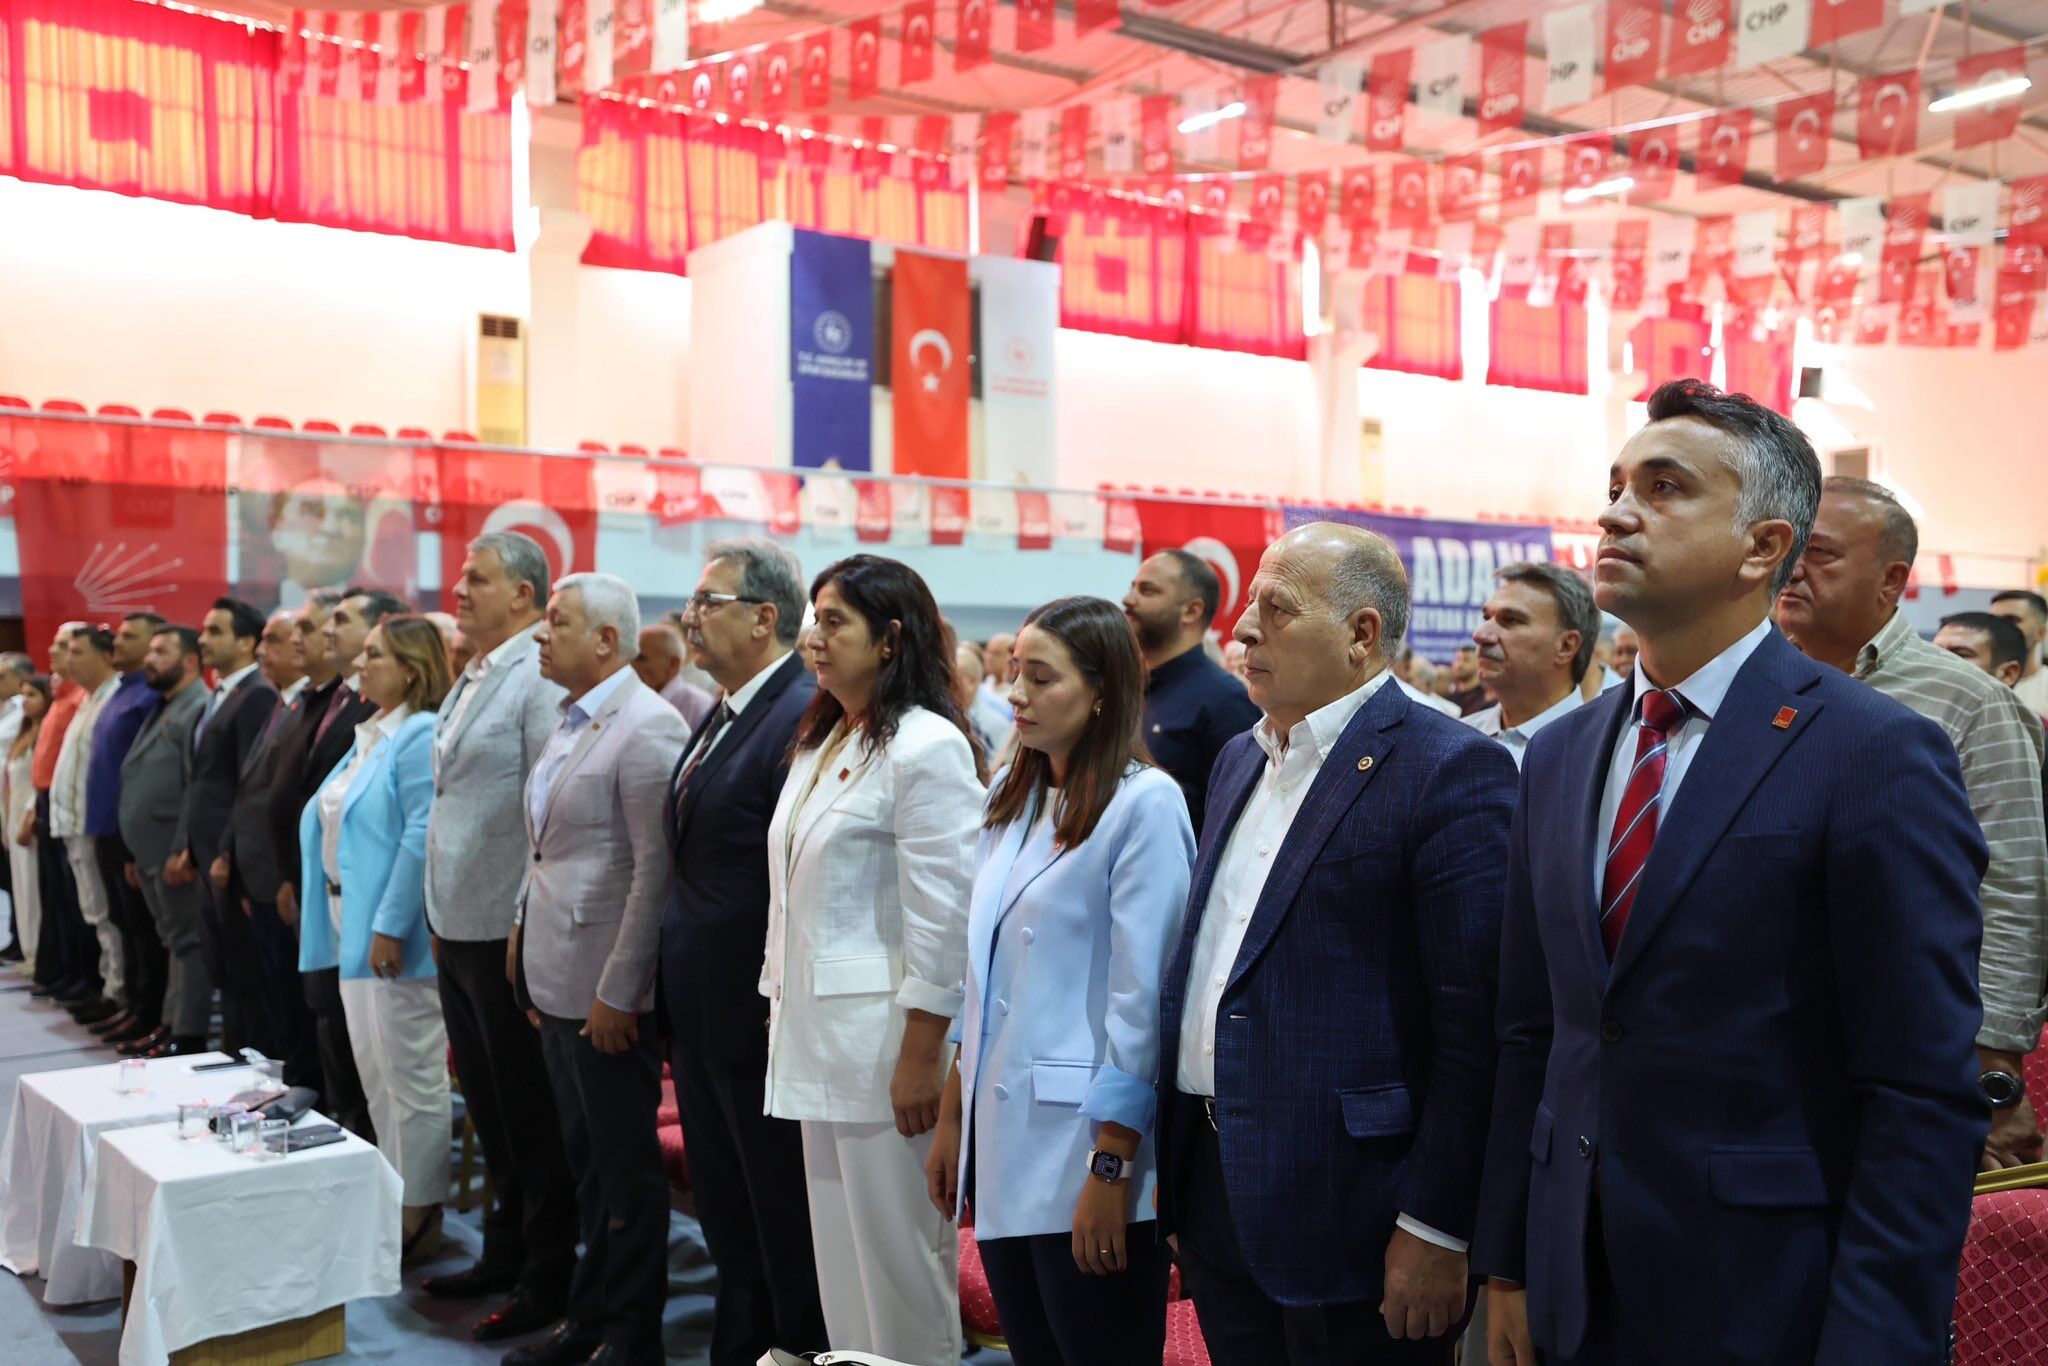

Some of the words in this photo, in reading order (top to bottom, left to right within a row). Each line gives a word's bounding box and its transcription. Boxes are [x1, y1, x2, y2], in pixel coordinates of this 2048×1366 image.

[1745, 1, 1788, 32] CHP
[1686, 18, 1724, 45] CHP
[1612, 38, 1650, 63] CHP
